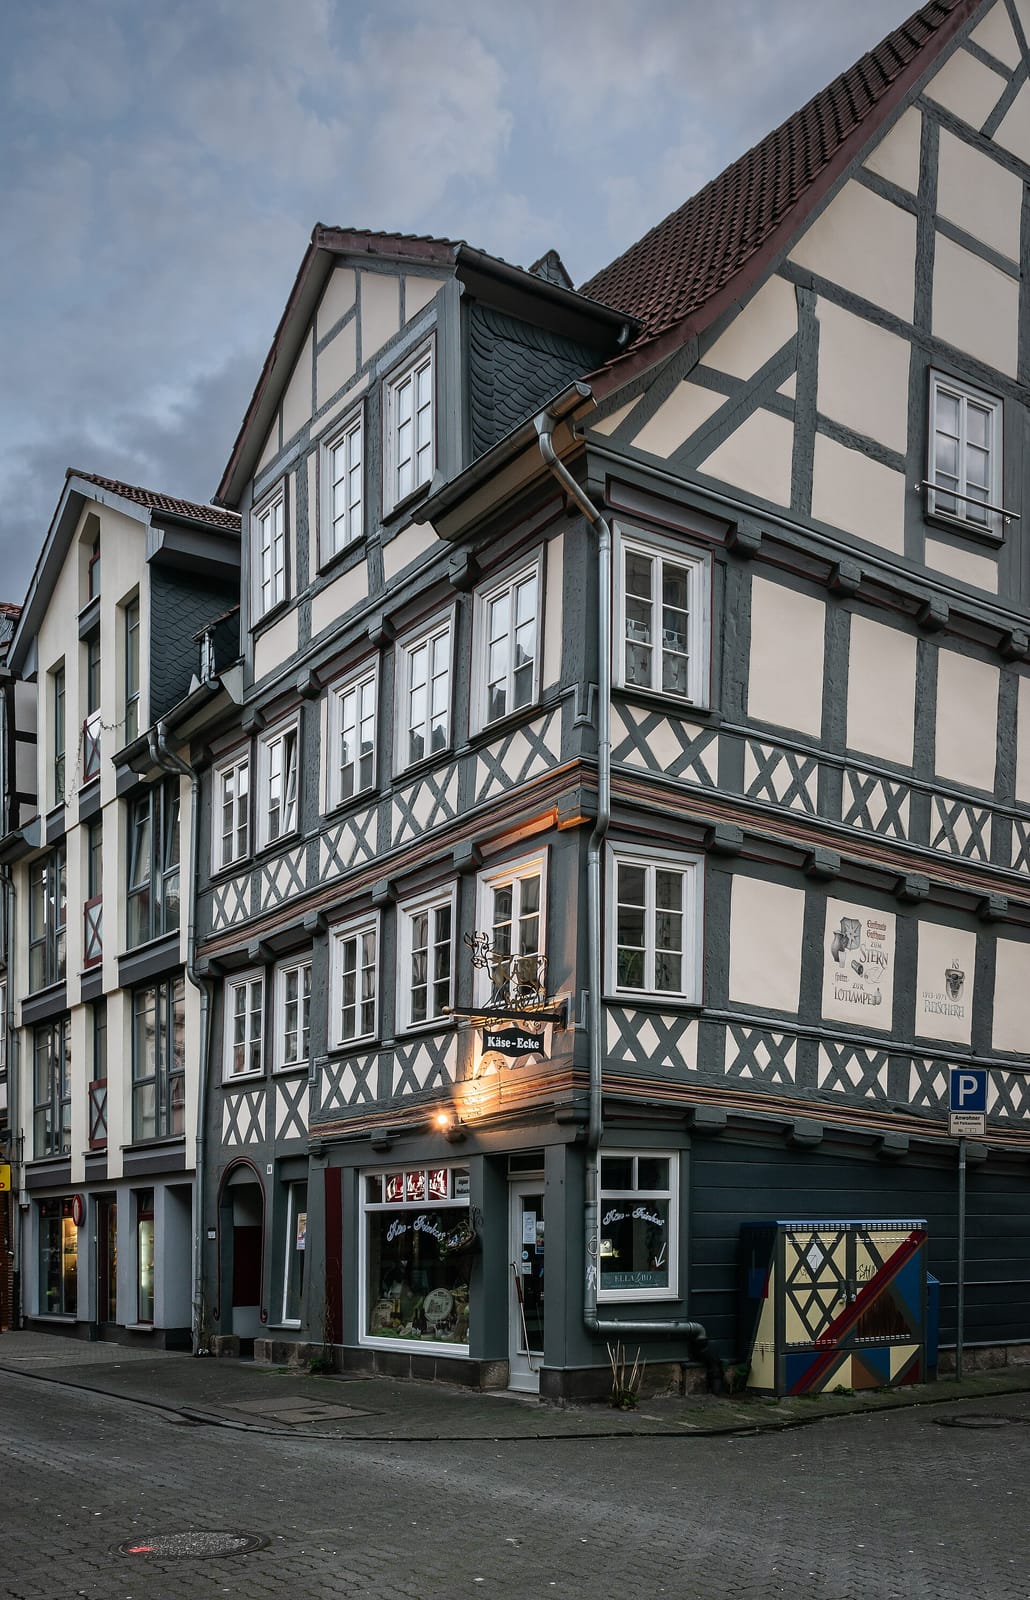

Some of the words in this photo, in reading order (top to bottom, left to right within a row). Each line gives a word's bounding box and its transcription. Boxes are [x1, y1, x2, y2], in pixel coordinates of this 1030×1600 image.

[859, 946, 889, 967] STERN
[487, 1036, 540, 1049] Käse-Ecke
[959, 1075, 978, 1106] P
